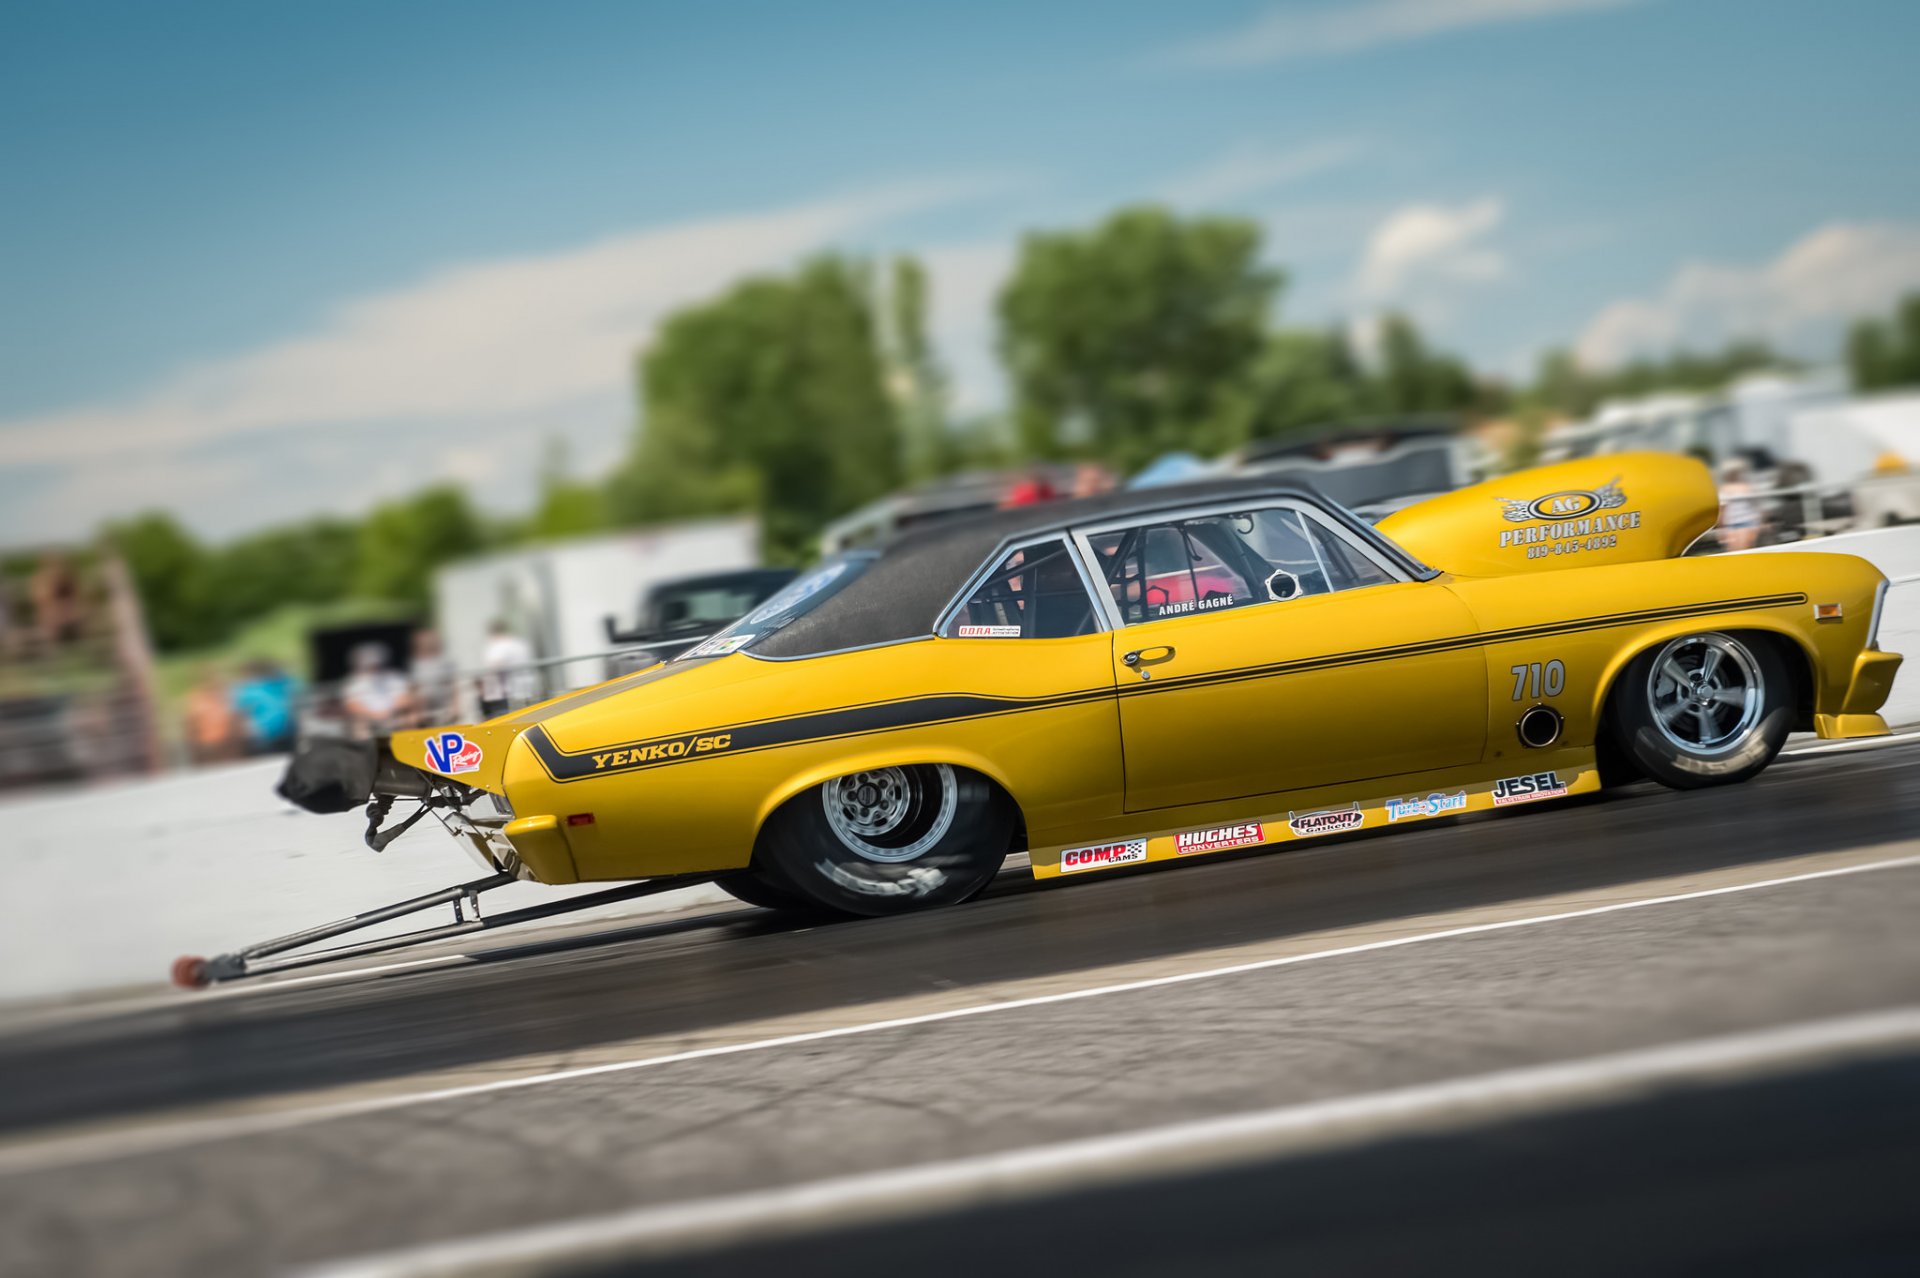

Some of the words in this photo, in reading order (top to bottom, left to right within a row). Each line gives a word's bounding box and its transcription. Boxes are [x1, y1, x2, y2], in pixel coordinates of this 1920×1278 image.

[1551, 496, 1581, 514] AG
[1499, 511, 1641, 547] PERFORMANCE
[1527, 534, 1617, 559] 819-845-4892
[1159, 600, 1195, 615] ANDRÉ
[1198, 594, 1234, 609] GAGNÉ
[1511, 659, 1566, 701] 710
[426, 733, 463, 773] VP
[592, 734, 732, 769] YENKO/SC
[1494, 772, 1565, 798] JESEL
[1300, 812, 1353, 829] FLATOUT
[1306, 823, 1352, 833] Gaskets
[1179, 823, 1259, 847] HUGHES
[1181, 836, 1259, 853] CONVERTERS
[1065, 844, 1127, 866] COMP
[1108, 854, 1138, 863] CAMS
